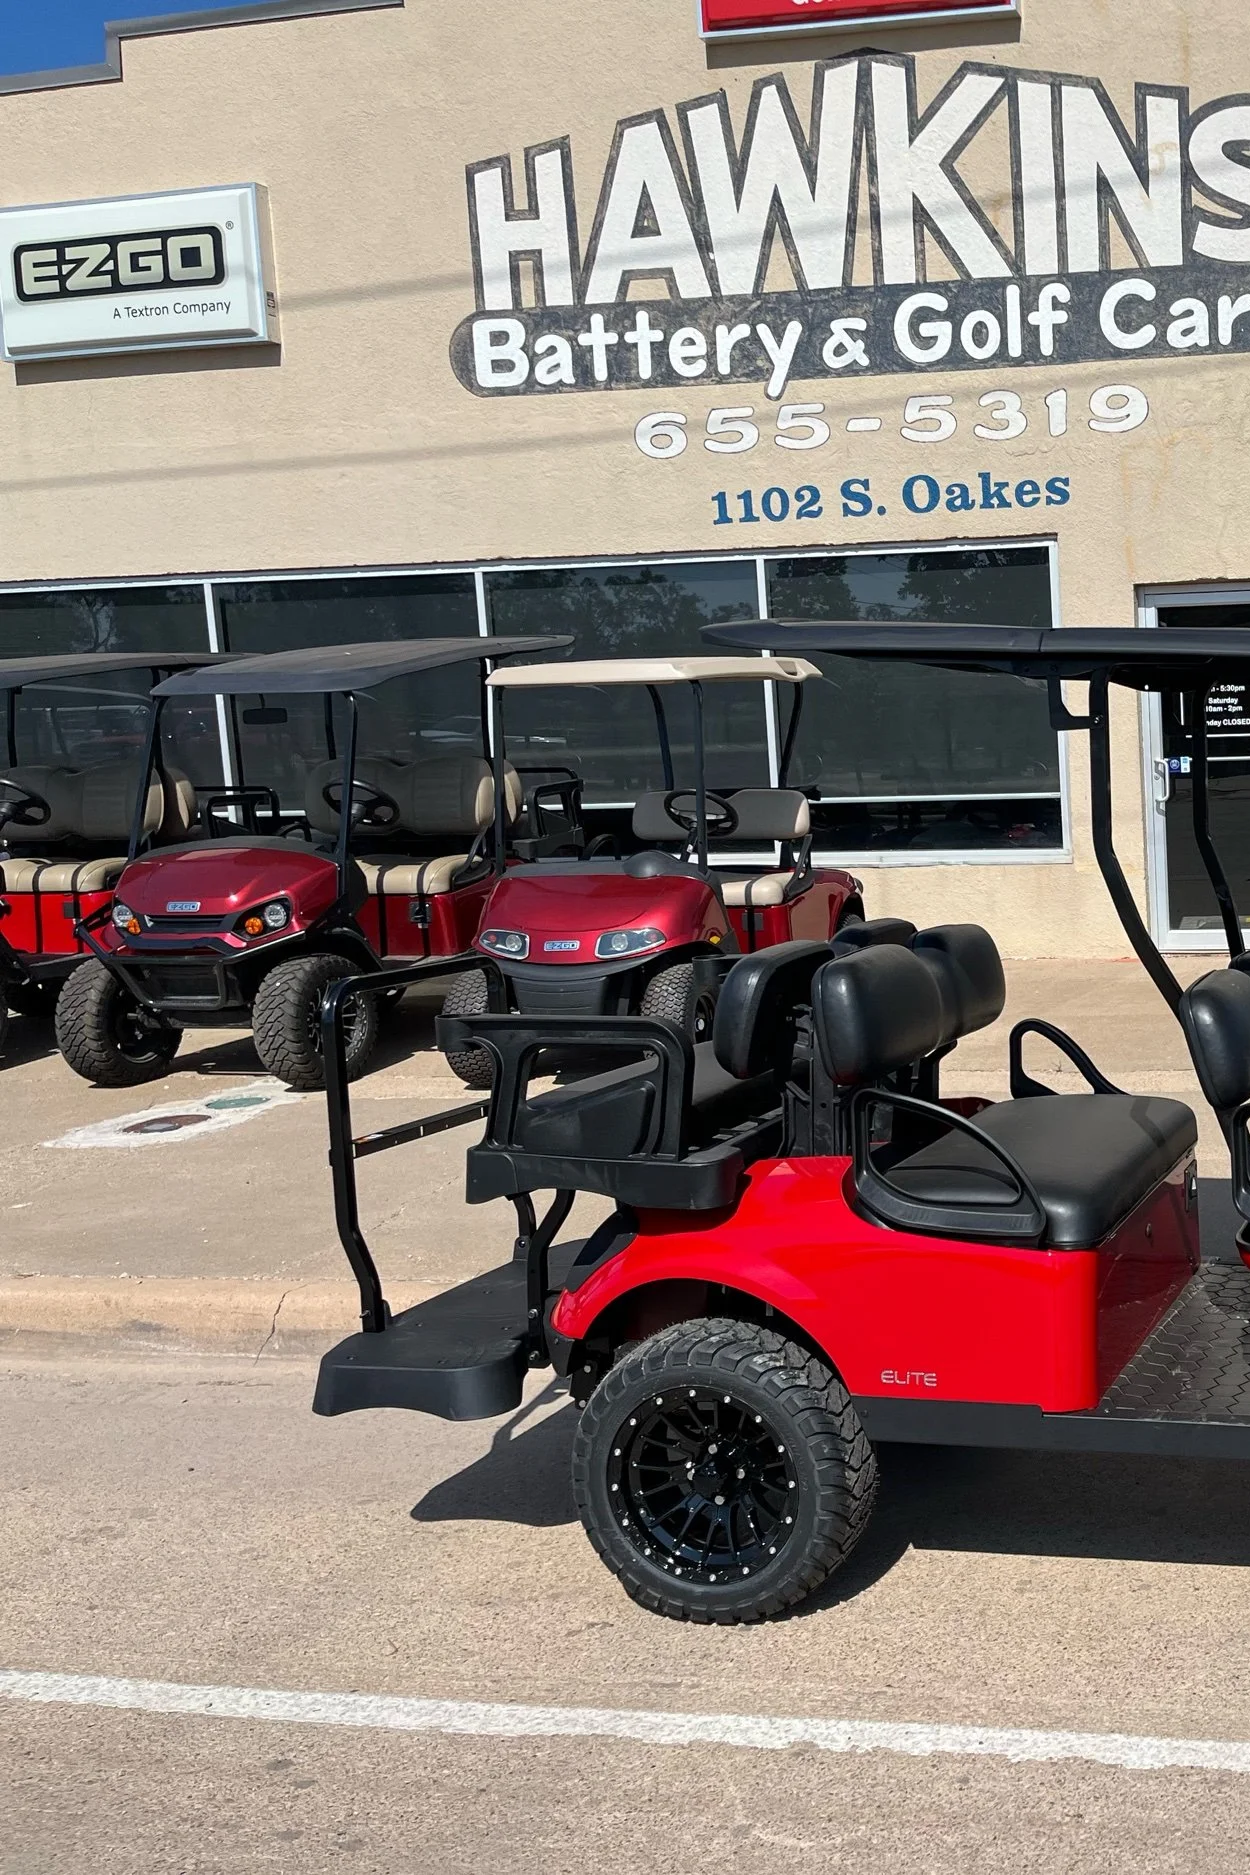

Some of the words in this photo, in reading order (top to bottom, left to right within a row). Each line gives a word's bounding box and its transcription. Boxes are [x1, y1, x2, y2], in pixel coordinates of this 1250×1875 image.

[113, 307, 121, 319] A
[124, 303, 169, 318] Textron
[173, 300, 231, 316] Company
[472, 310, 803, 400] Battery
[822, 317, 870, 369] &
[893, 282, 1071, 363] Golf
[634, 383, 1150, 460] 655-5319
[711, 484, 823, 526] 1102
[841, 477, 886, 518] S.
[902, 471, 1071, 513] Oakes
[1208, 697, 1239, 705] Saturday
[1228, 705, 1243, 713] 2pm
